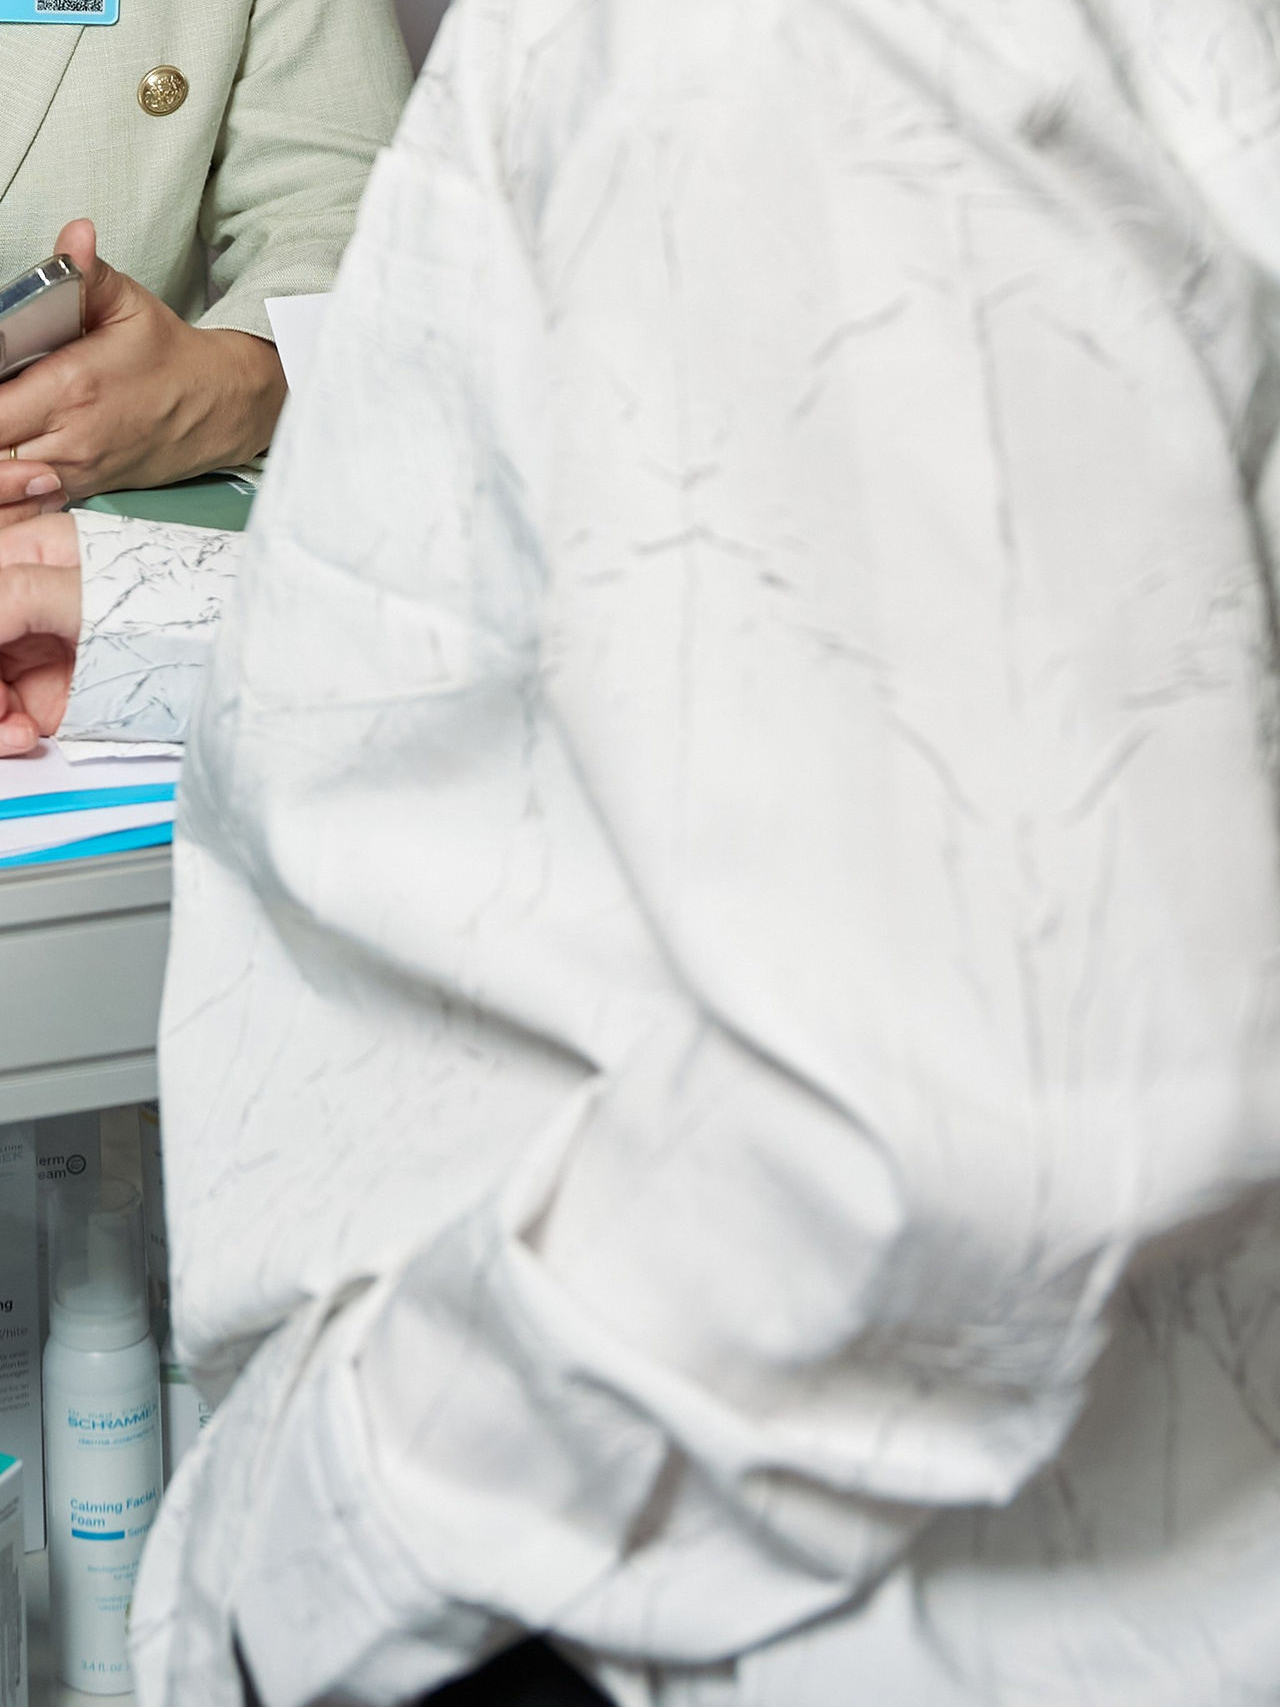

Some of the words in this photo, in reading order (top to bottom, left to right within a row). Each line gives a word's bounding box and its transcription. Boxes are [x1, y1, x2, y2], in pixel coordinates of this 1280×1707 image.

[70, 1498, 123, 1515] Calming
[126, 1487, 157, 1510] Facial
[71, 1511, 106, 1527] Foam
